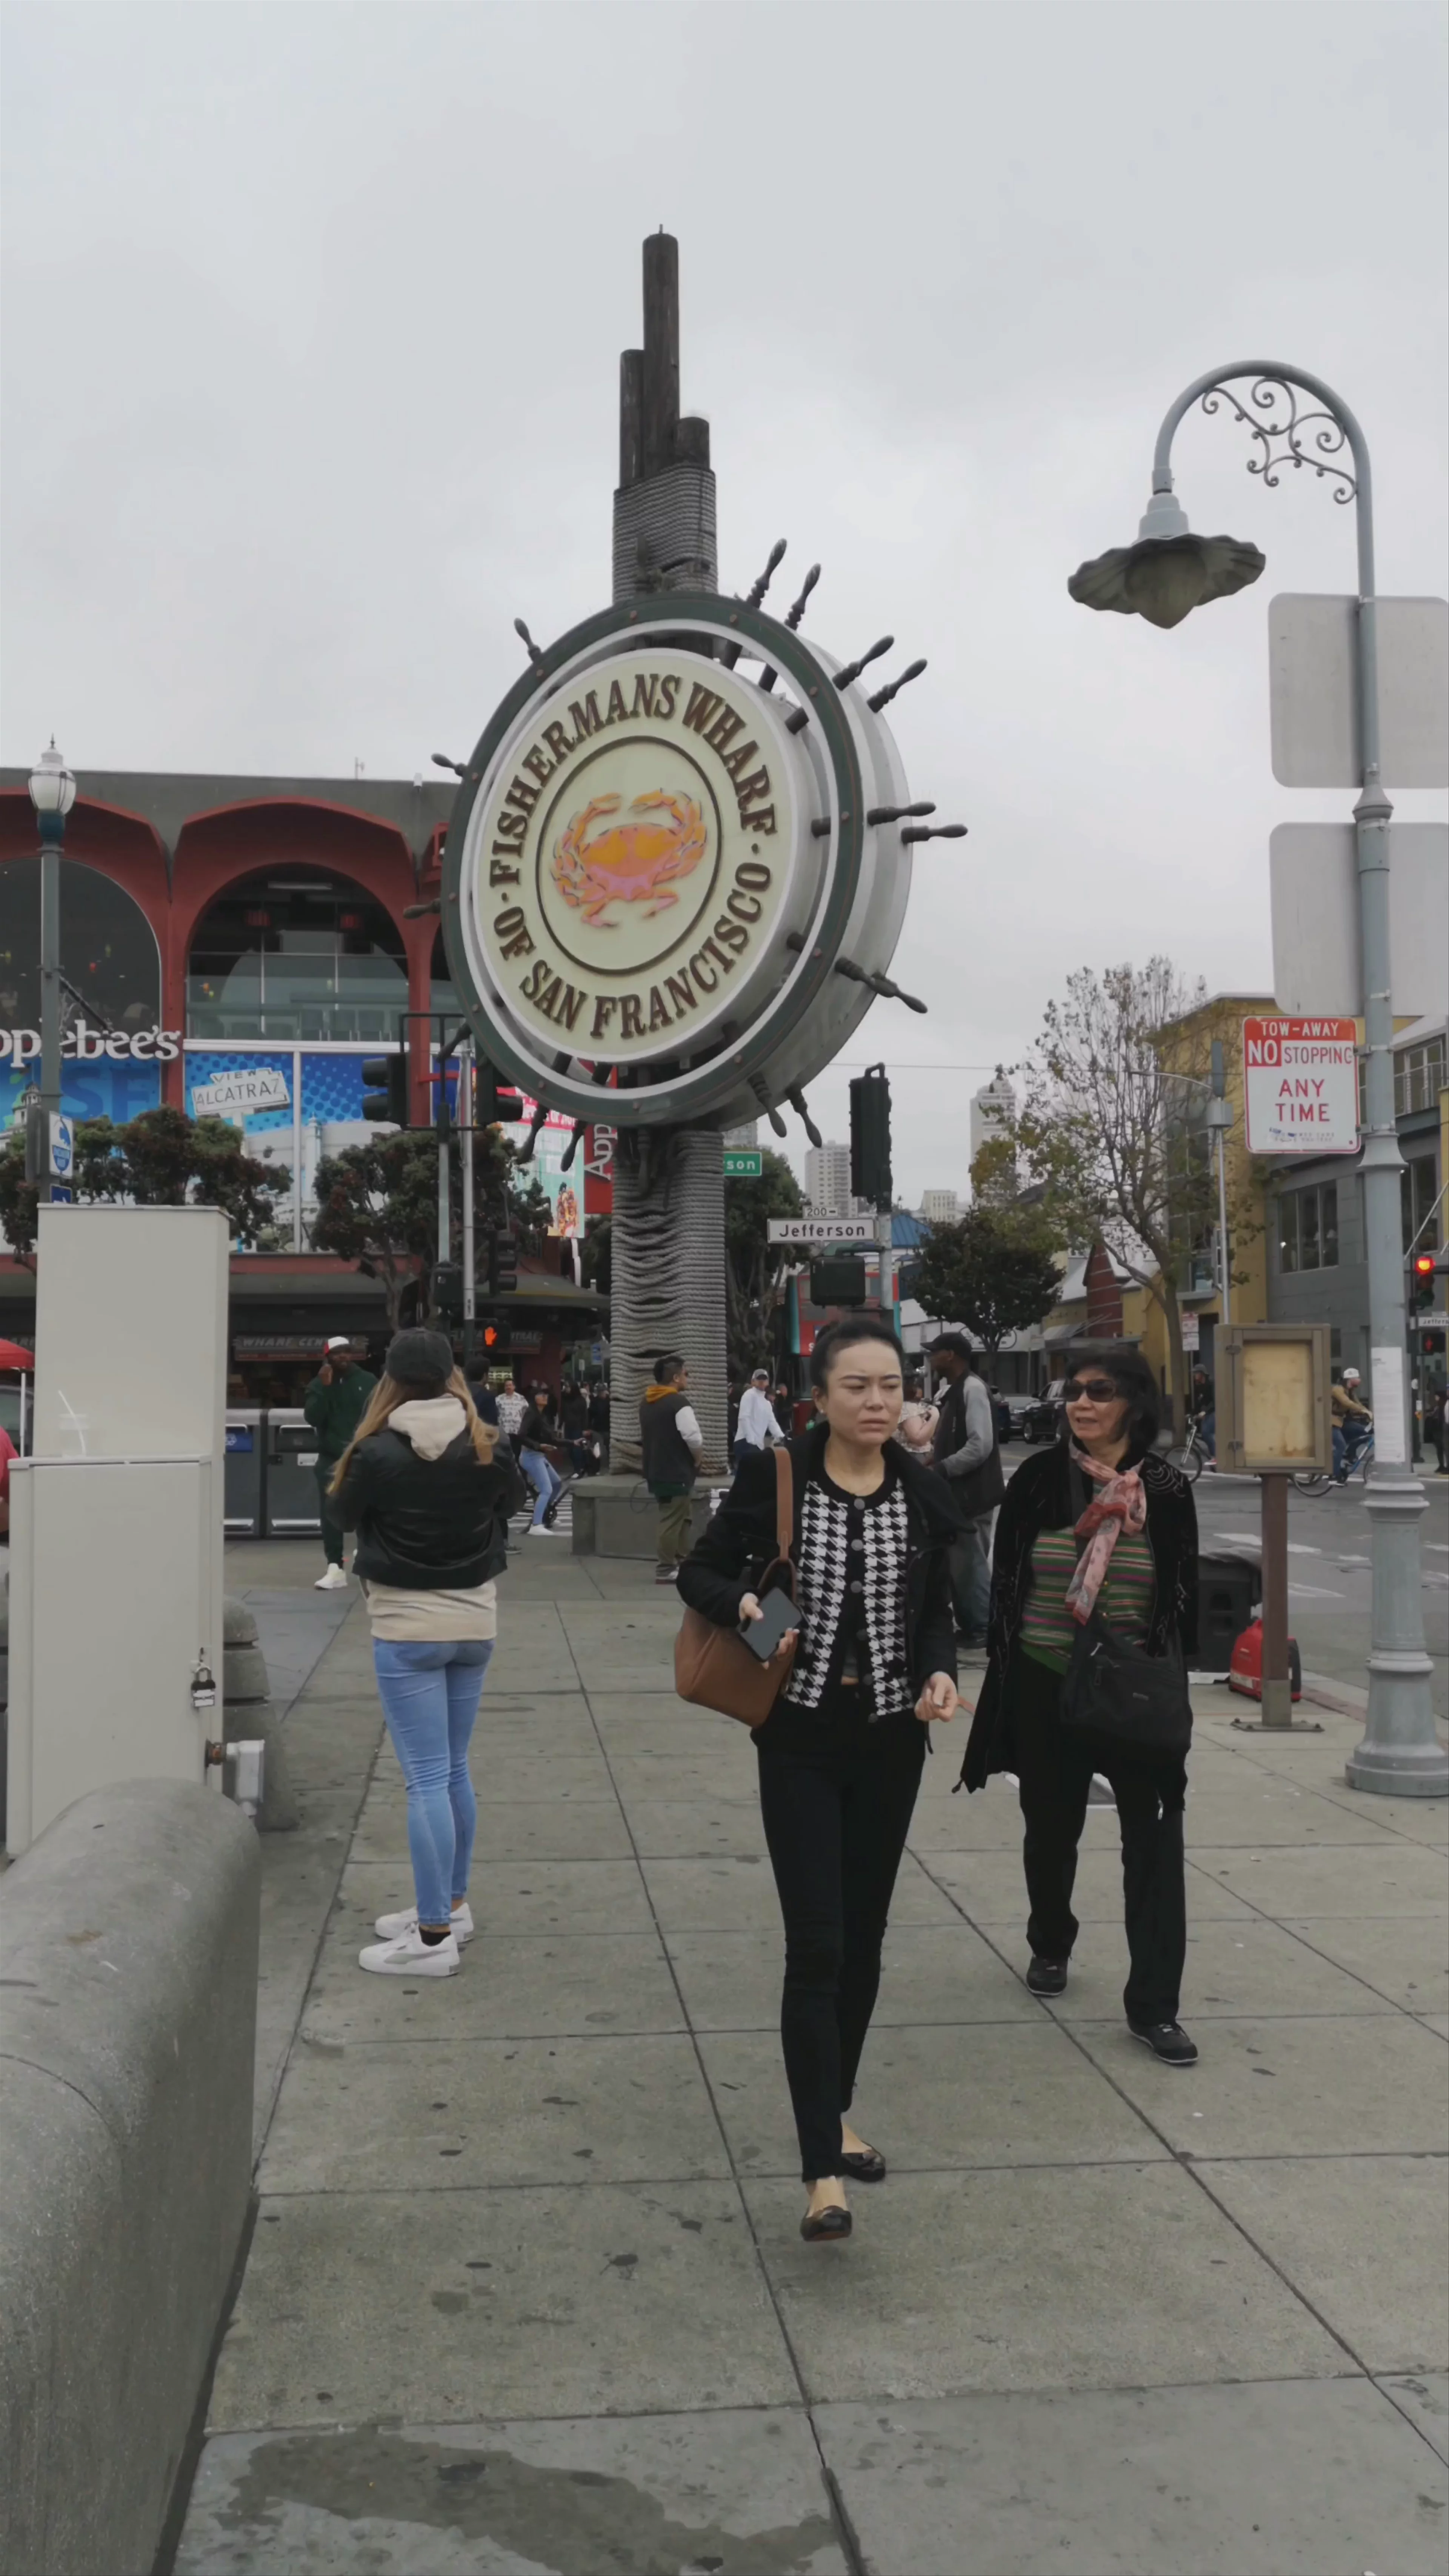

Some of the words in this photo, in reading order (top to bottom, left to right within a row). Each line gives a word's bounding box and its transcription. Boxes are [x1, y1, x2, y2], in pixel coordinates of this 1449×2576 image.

[490, 674, 682, 888] FISHERMANS
[682, 681, 778, 837] WHARF
[494, 906, 537, 961] OF
[519, 959, 589, 1032] SAN
[590, 862, 771, 1040] FRANCISCO
[1261, 1021, 1338, 1037] TOW-AWAY
[1248, 1040, 1278, 1064] NO
[1284, 1046, 1352, 1064] STOPPING
[213, 1069, 257, 1083] VIEW
[195, 1078, 279, 1106] ALCATRAZ
[1278, 1079, 1325, 1098] ANY
[1275, 1103, 1331, 1122] TIME
[723, 1158, 755, 1169] son
[779, 1224, 865, 1237] Jefferson
